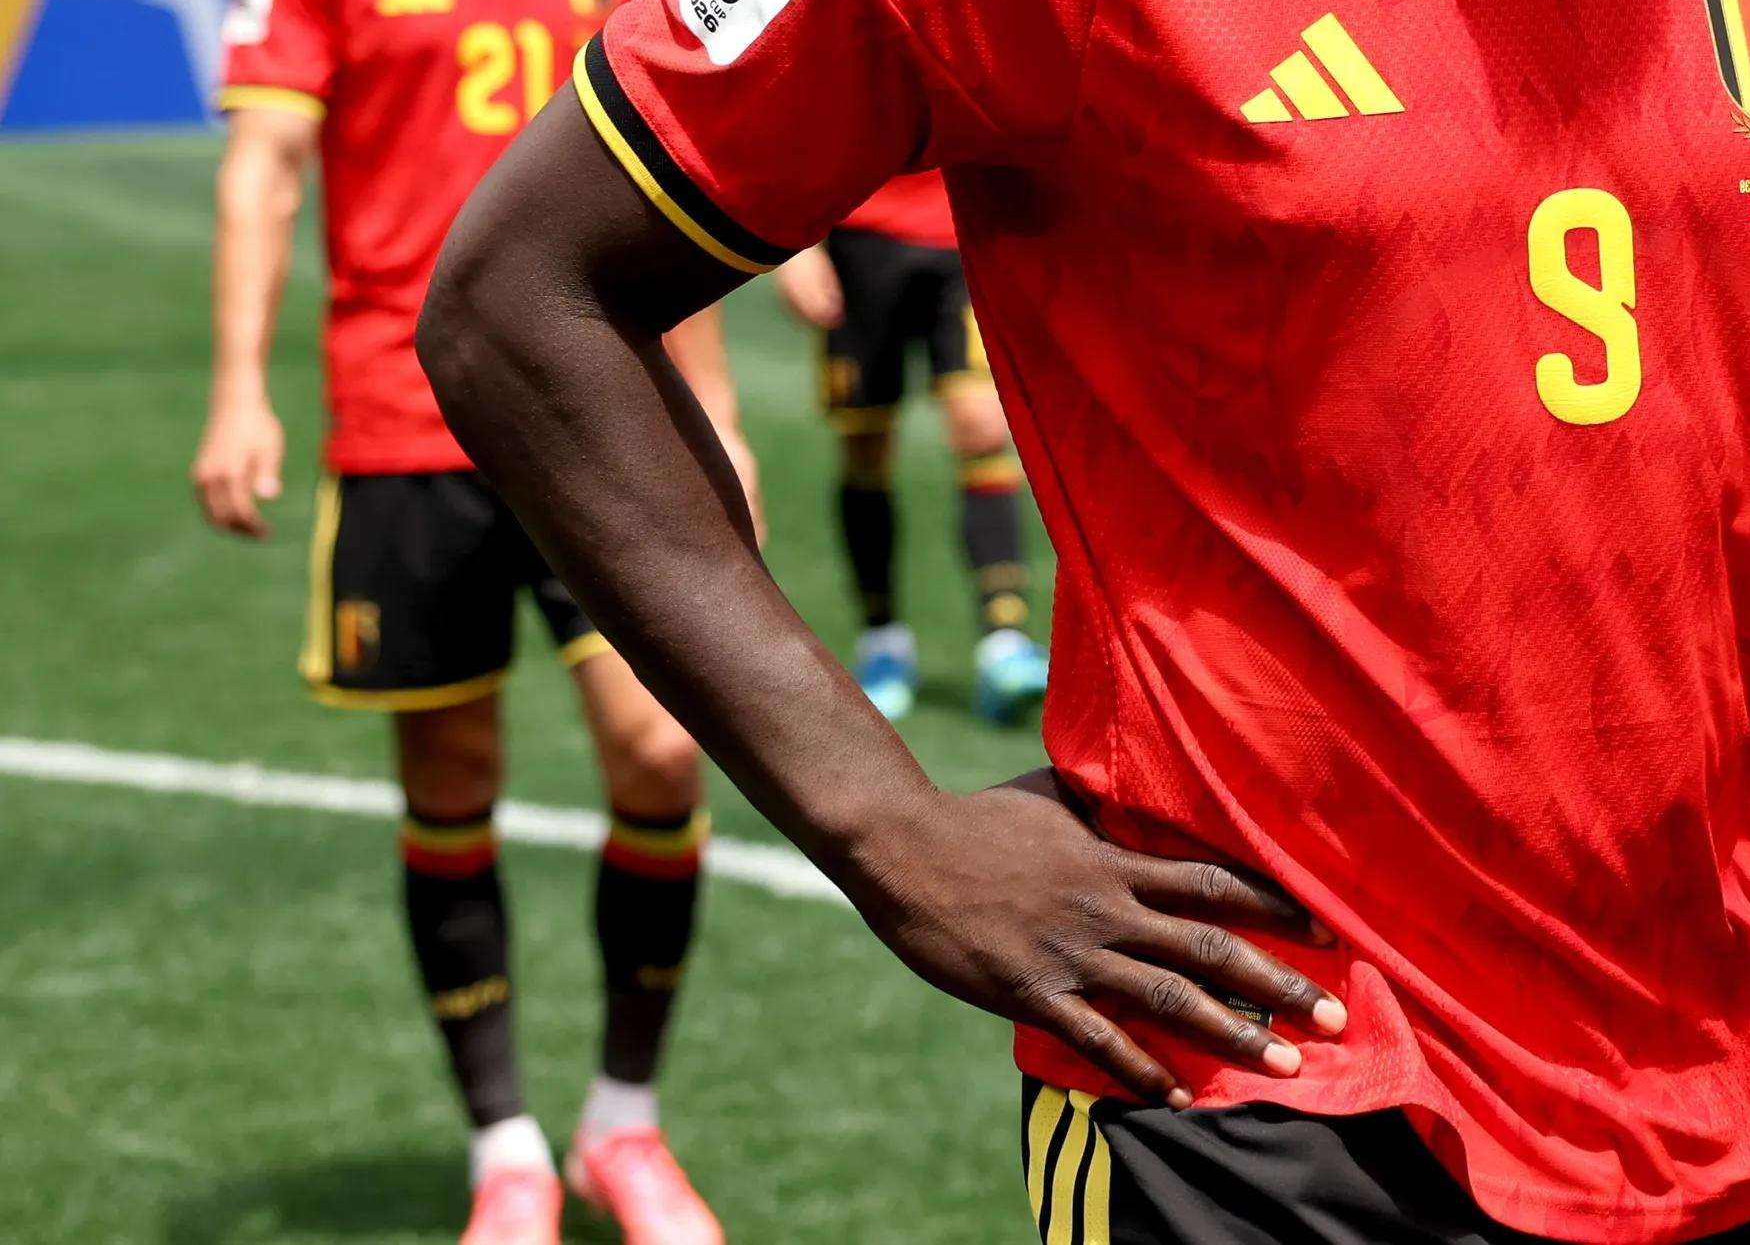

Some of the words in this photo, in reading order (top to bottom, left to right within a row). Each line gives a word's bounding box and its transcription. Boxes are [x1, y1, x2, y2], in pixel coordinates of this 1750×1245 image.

[710, 0, 727, 19] CUP
[455, 17, 555, 136] 21
[1527, 188, 1642, 426] 9
